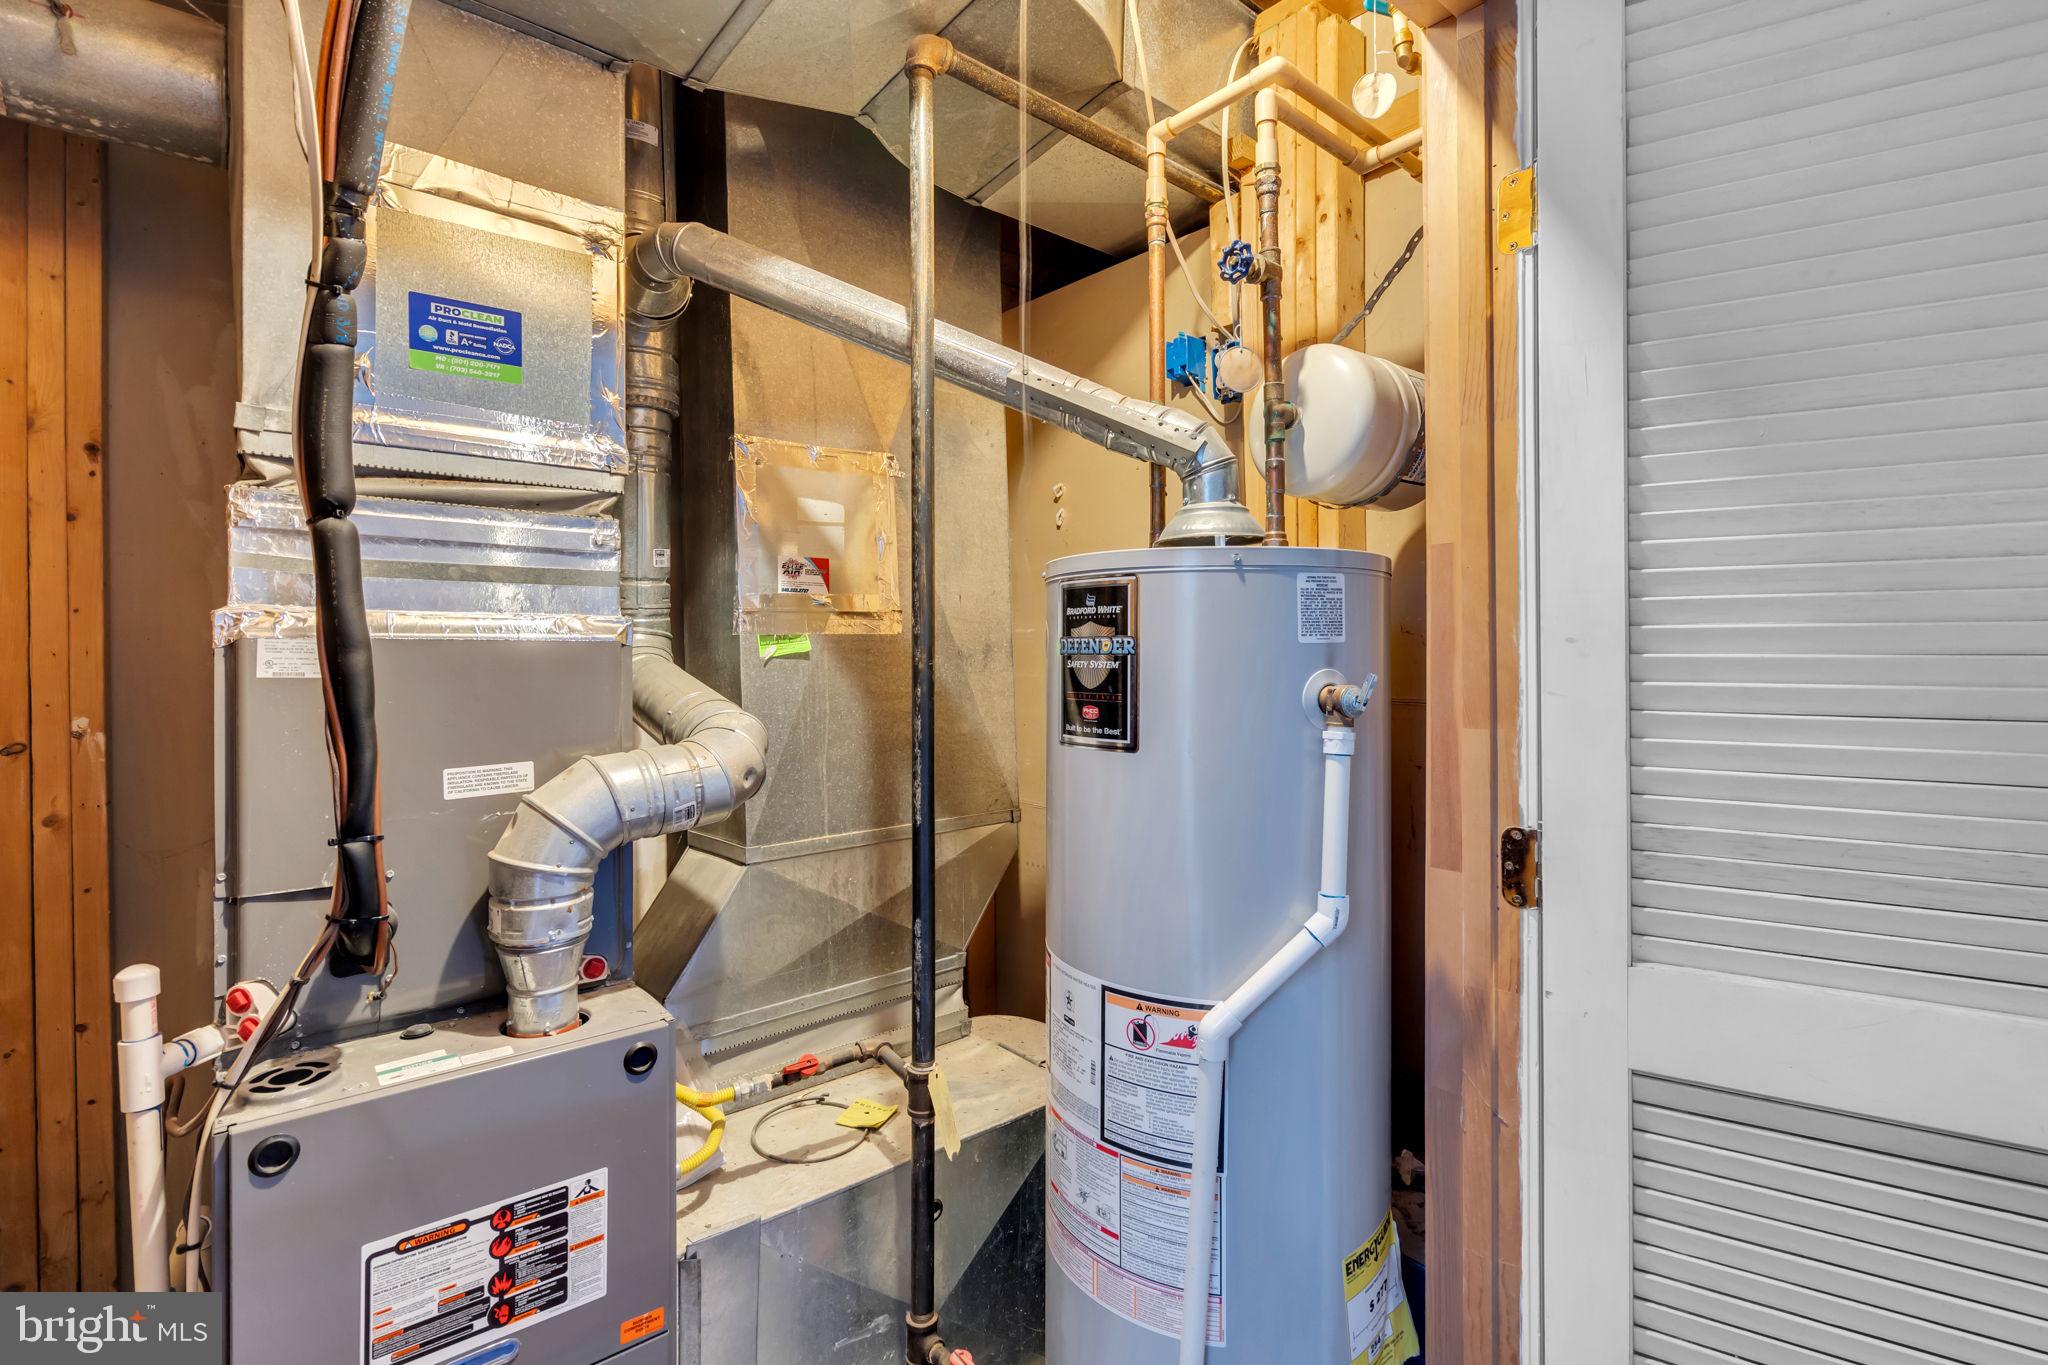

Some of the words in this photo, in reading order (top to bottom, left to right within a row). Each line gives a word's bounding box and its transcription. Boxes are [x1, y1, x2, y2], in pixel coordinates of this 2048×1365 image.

[434, 304, 503, 326] PROCLEAN
[438, 316, 452, 324] Duct
[458, 320, 472, 328] Mold
[473, 324, 507, 334] Remediation
[461, 337, 472, 346] A+
[493, 341, 516, 351] NADCA
[1067, 606, 1096, 615] BRADFORD
[1097, 605, 1121, 613] WHITE
[1060, 635, 1136, 656] DEFENDER
[1067, 660, 1089, 669] SAFETY
[1089, 660, 1119, 669] SYSTEM
[1076, 723, 1083, 732] to
[1084, 725, 1092, 733] be
[1092, 726, 1103, 734] the
[1104, 727, 1121, 736] Best
[1144, 1004, 1180, 1017] WARNING
[1144, 1057, 1169, 1067] EXPLOSION
[414, 1226, 457, 1246] WARNING
